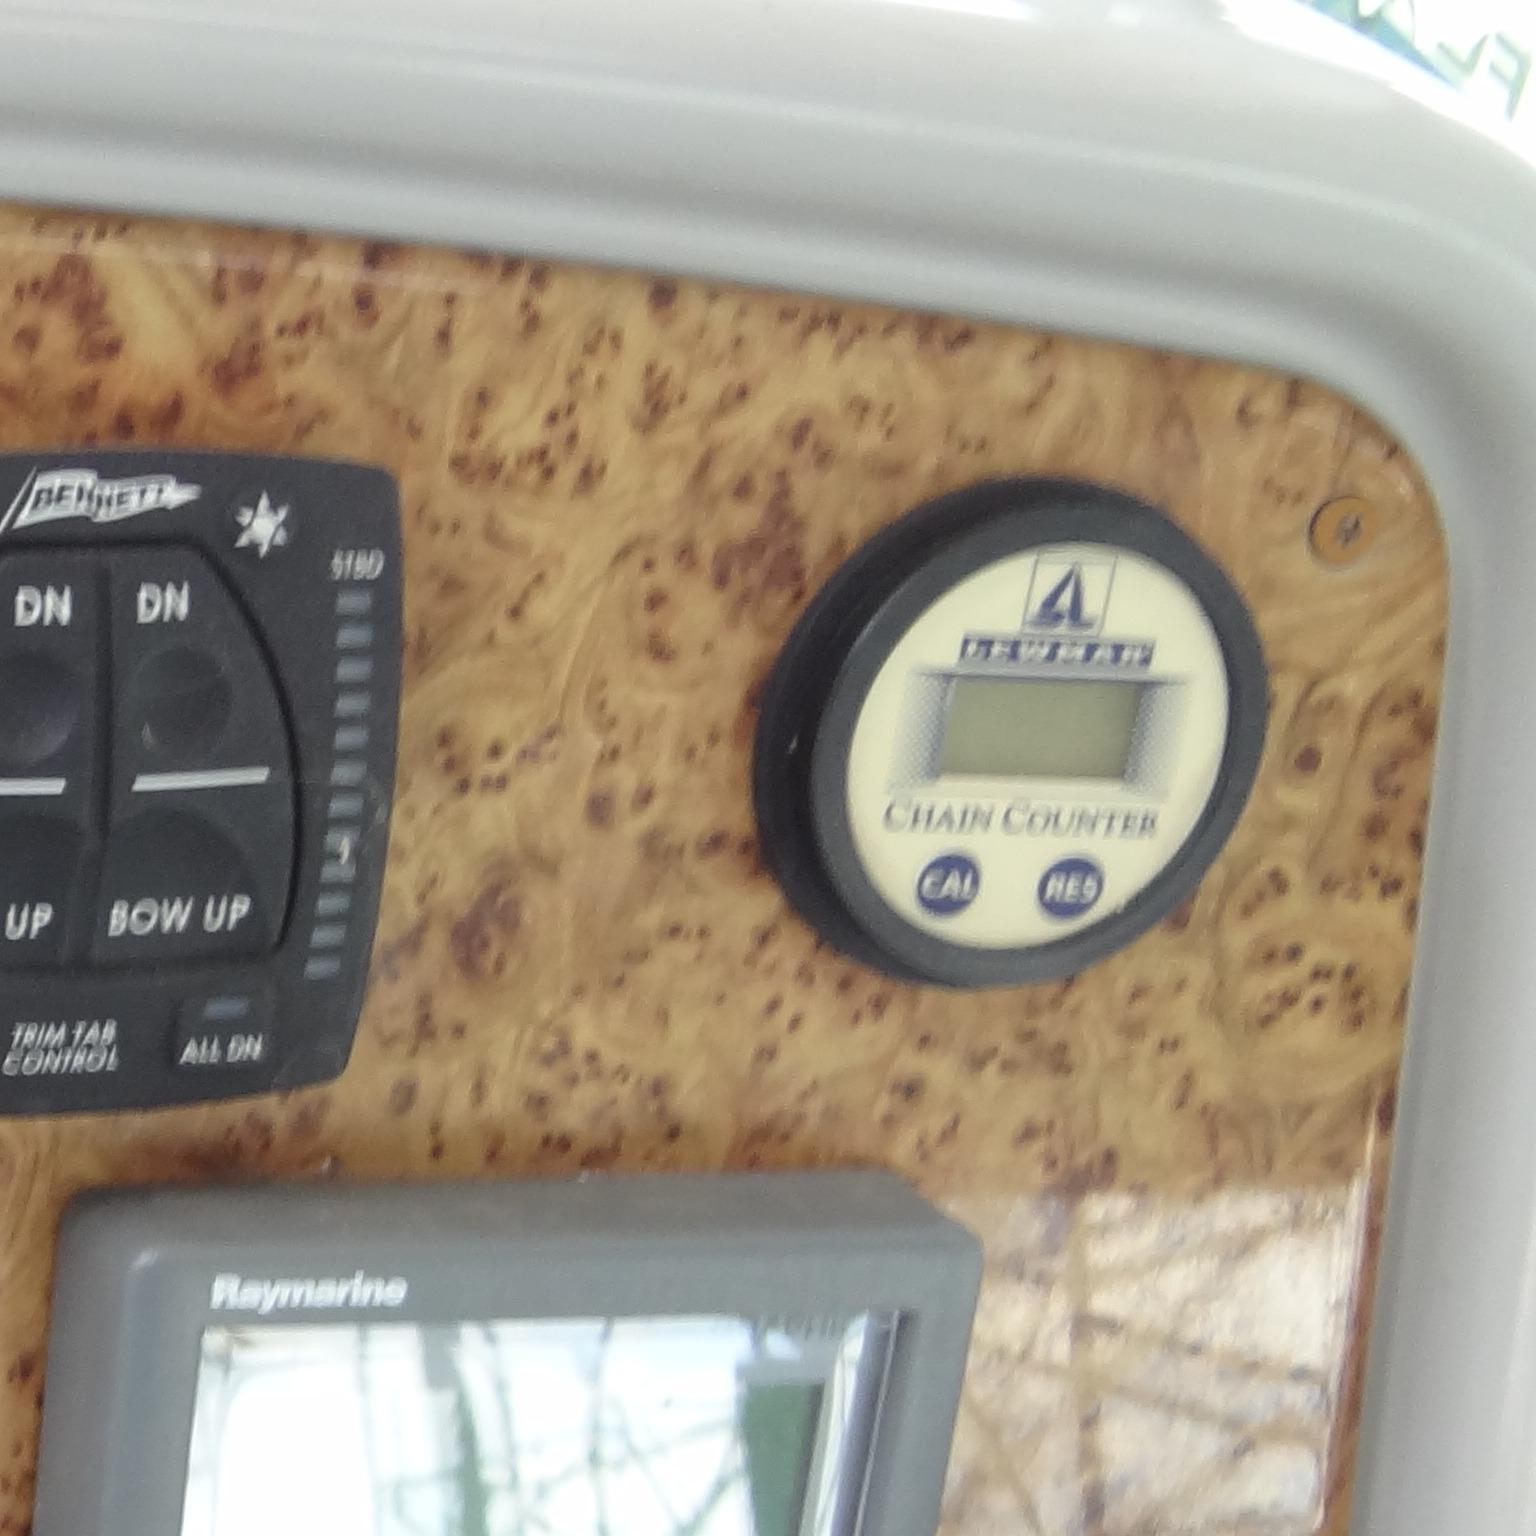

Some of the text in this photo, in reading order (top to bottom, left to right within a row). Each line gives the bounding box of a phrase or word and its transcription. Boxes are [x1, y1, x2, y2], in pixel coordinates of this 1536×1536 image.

[13, 583, 73, 627] DN
[135, 579, 192, 624] DN
[4, 902, 55, 942] UP
[106, 892, 253, 938] BOW UP
[10, 1018, 118, 1050] TRIM TAB
[179, 1032, 264, 1067] ALL DN
[1, 1045, 121, 1077] CONTROL
[209, 1269, 410, 1315] Raymarine
